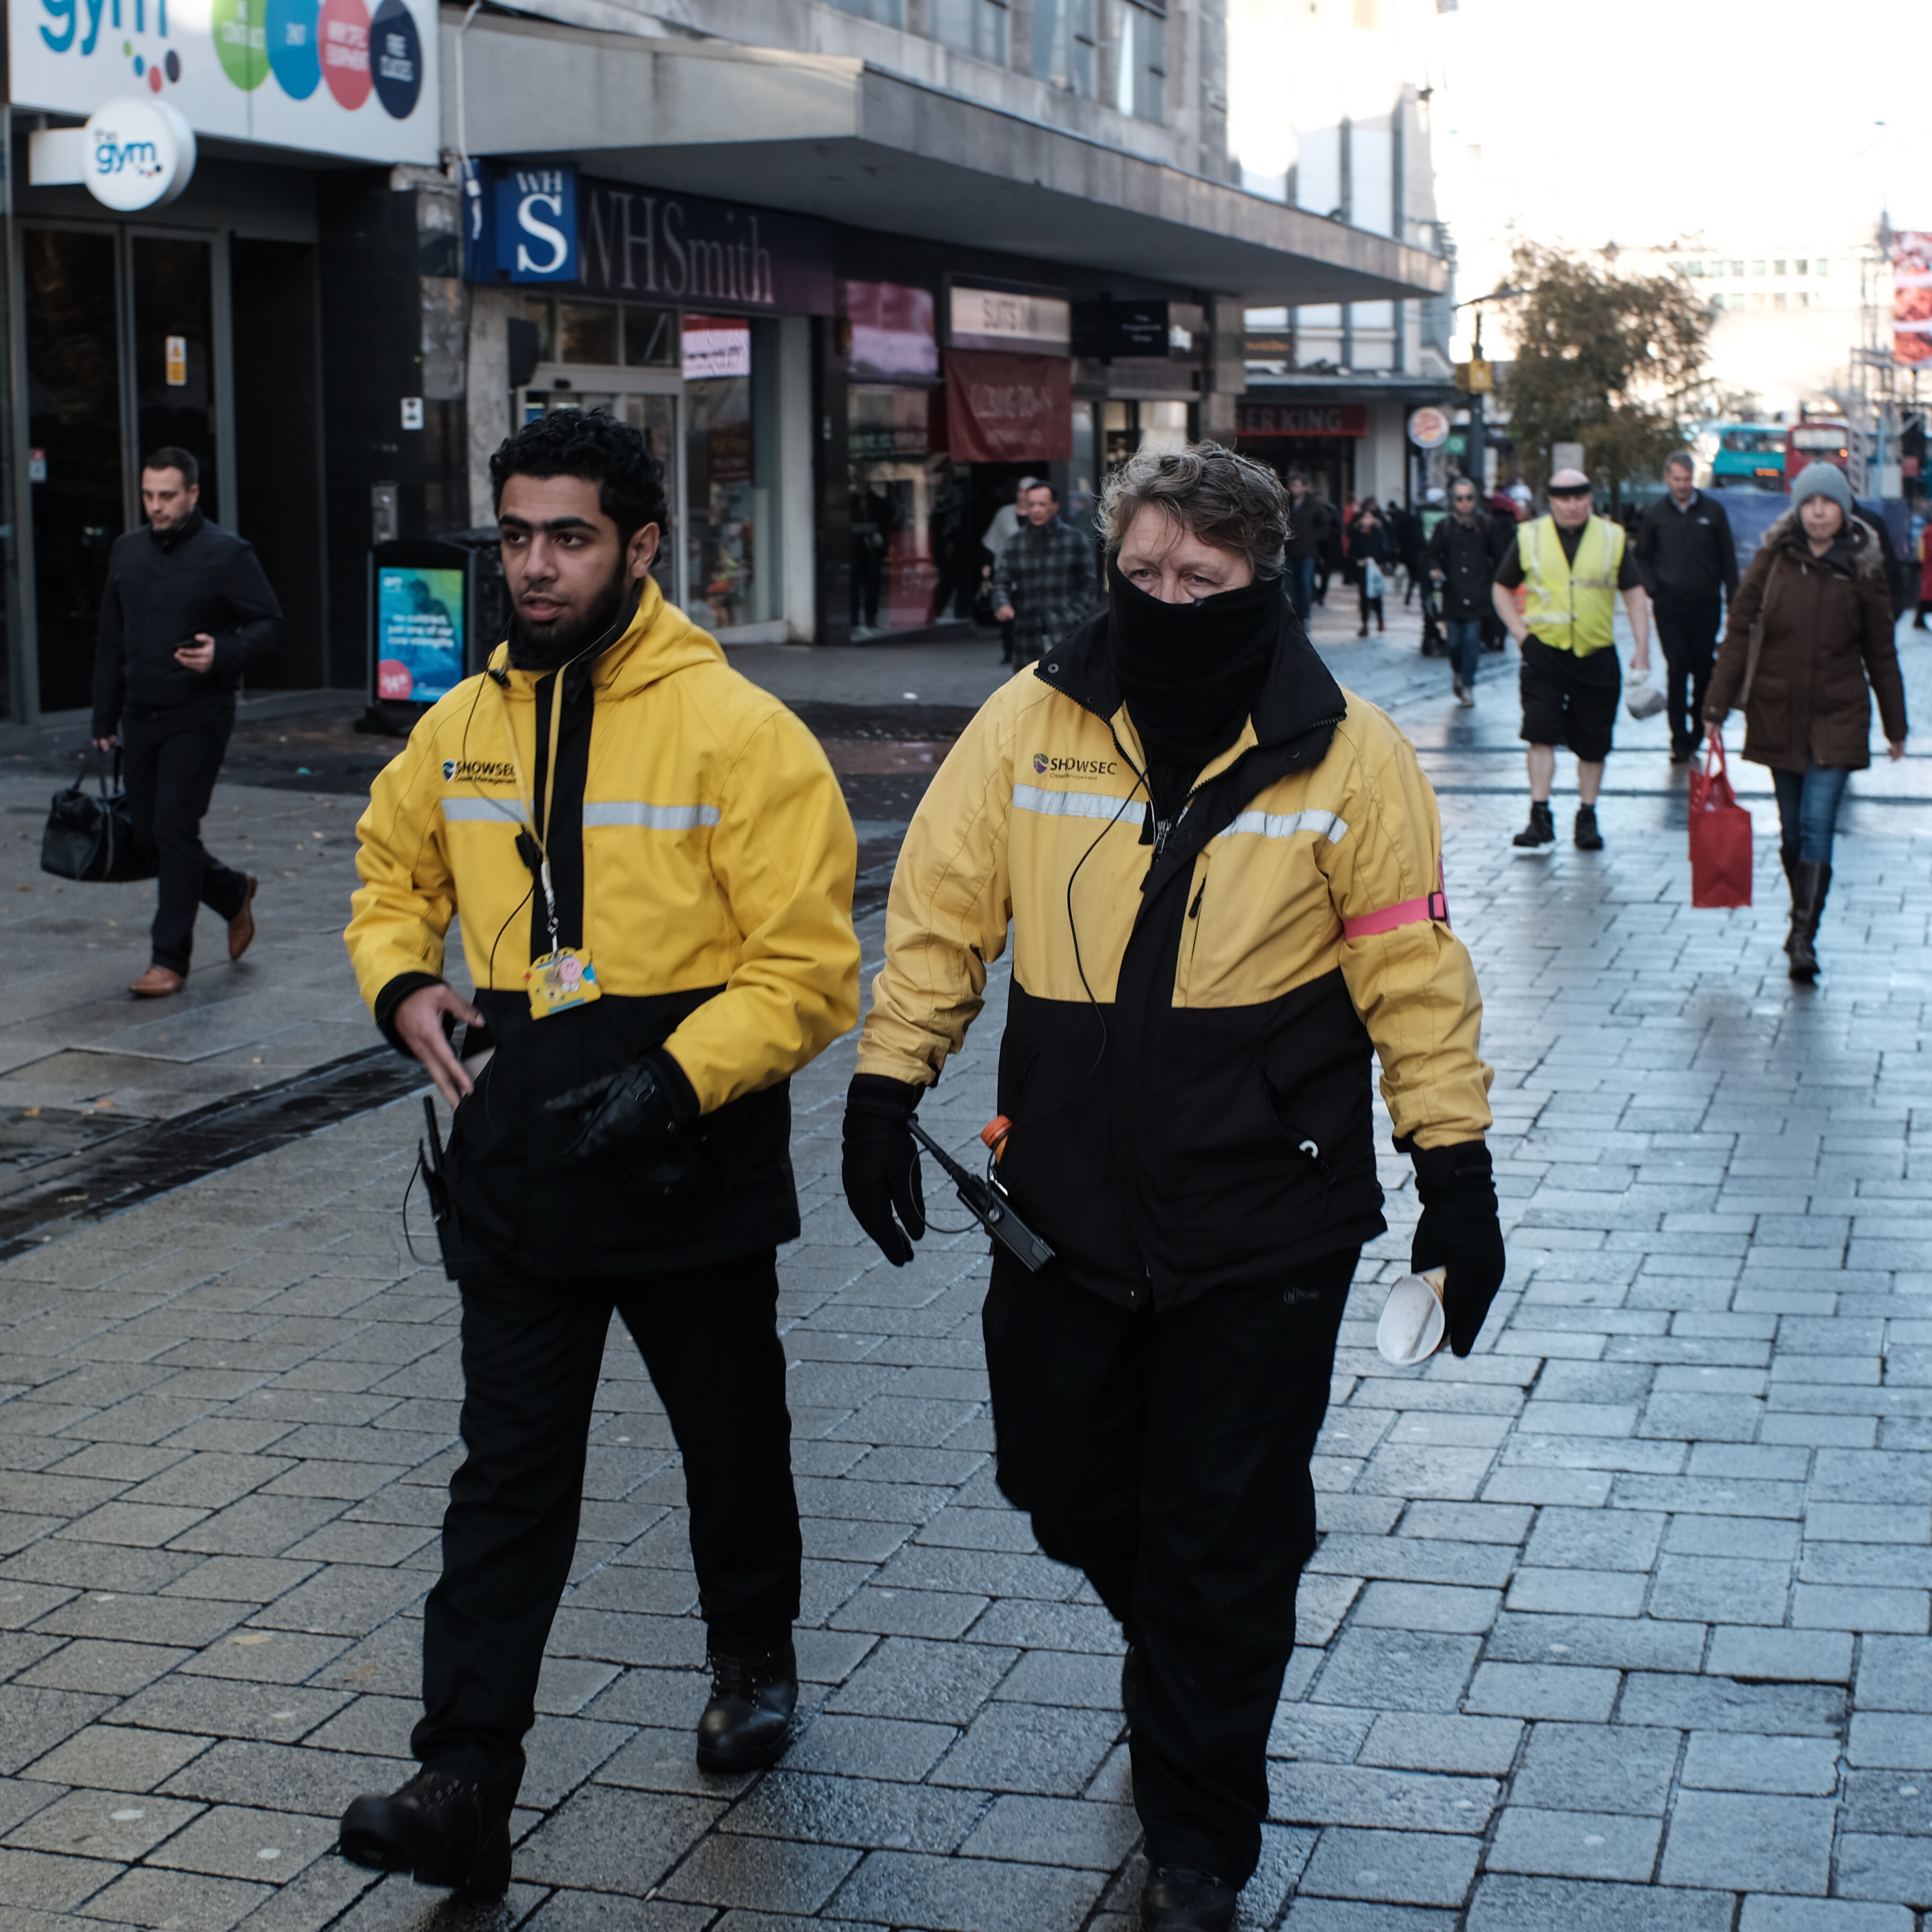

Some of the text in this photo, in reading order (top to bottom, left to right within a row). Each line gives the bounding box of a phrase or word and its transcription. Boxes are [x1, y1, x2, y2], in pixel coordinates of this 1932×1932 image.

[96, 142, 156, 173] gym
[516, 169, 562, 194] WH
[517, 194, 568, 274] S
[1281, 407, 1342, 433] KING
[1050, 757, 1118, 775] SHOWSEC
